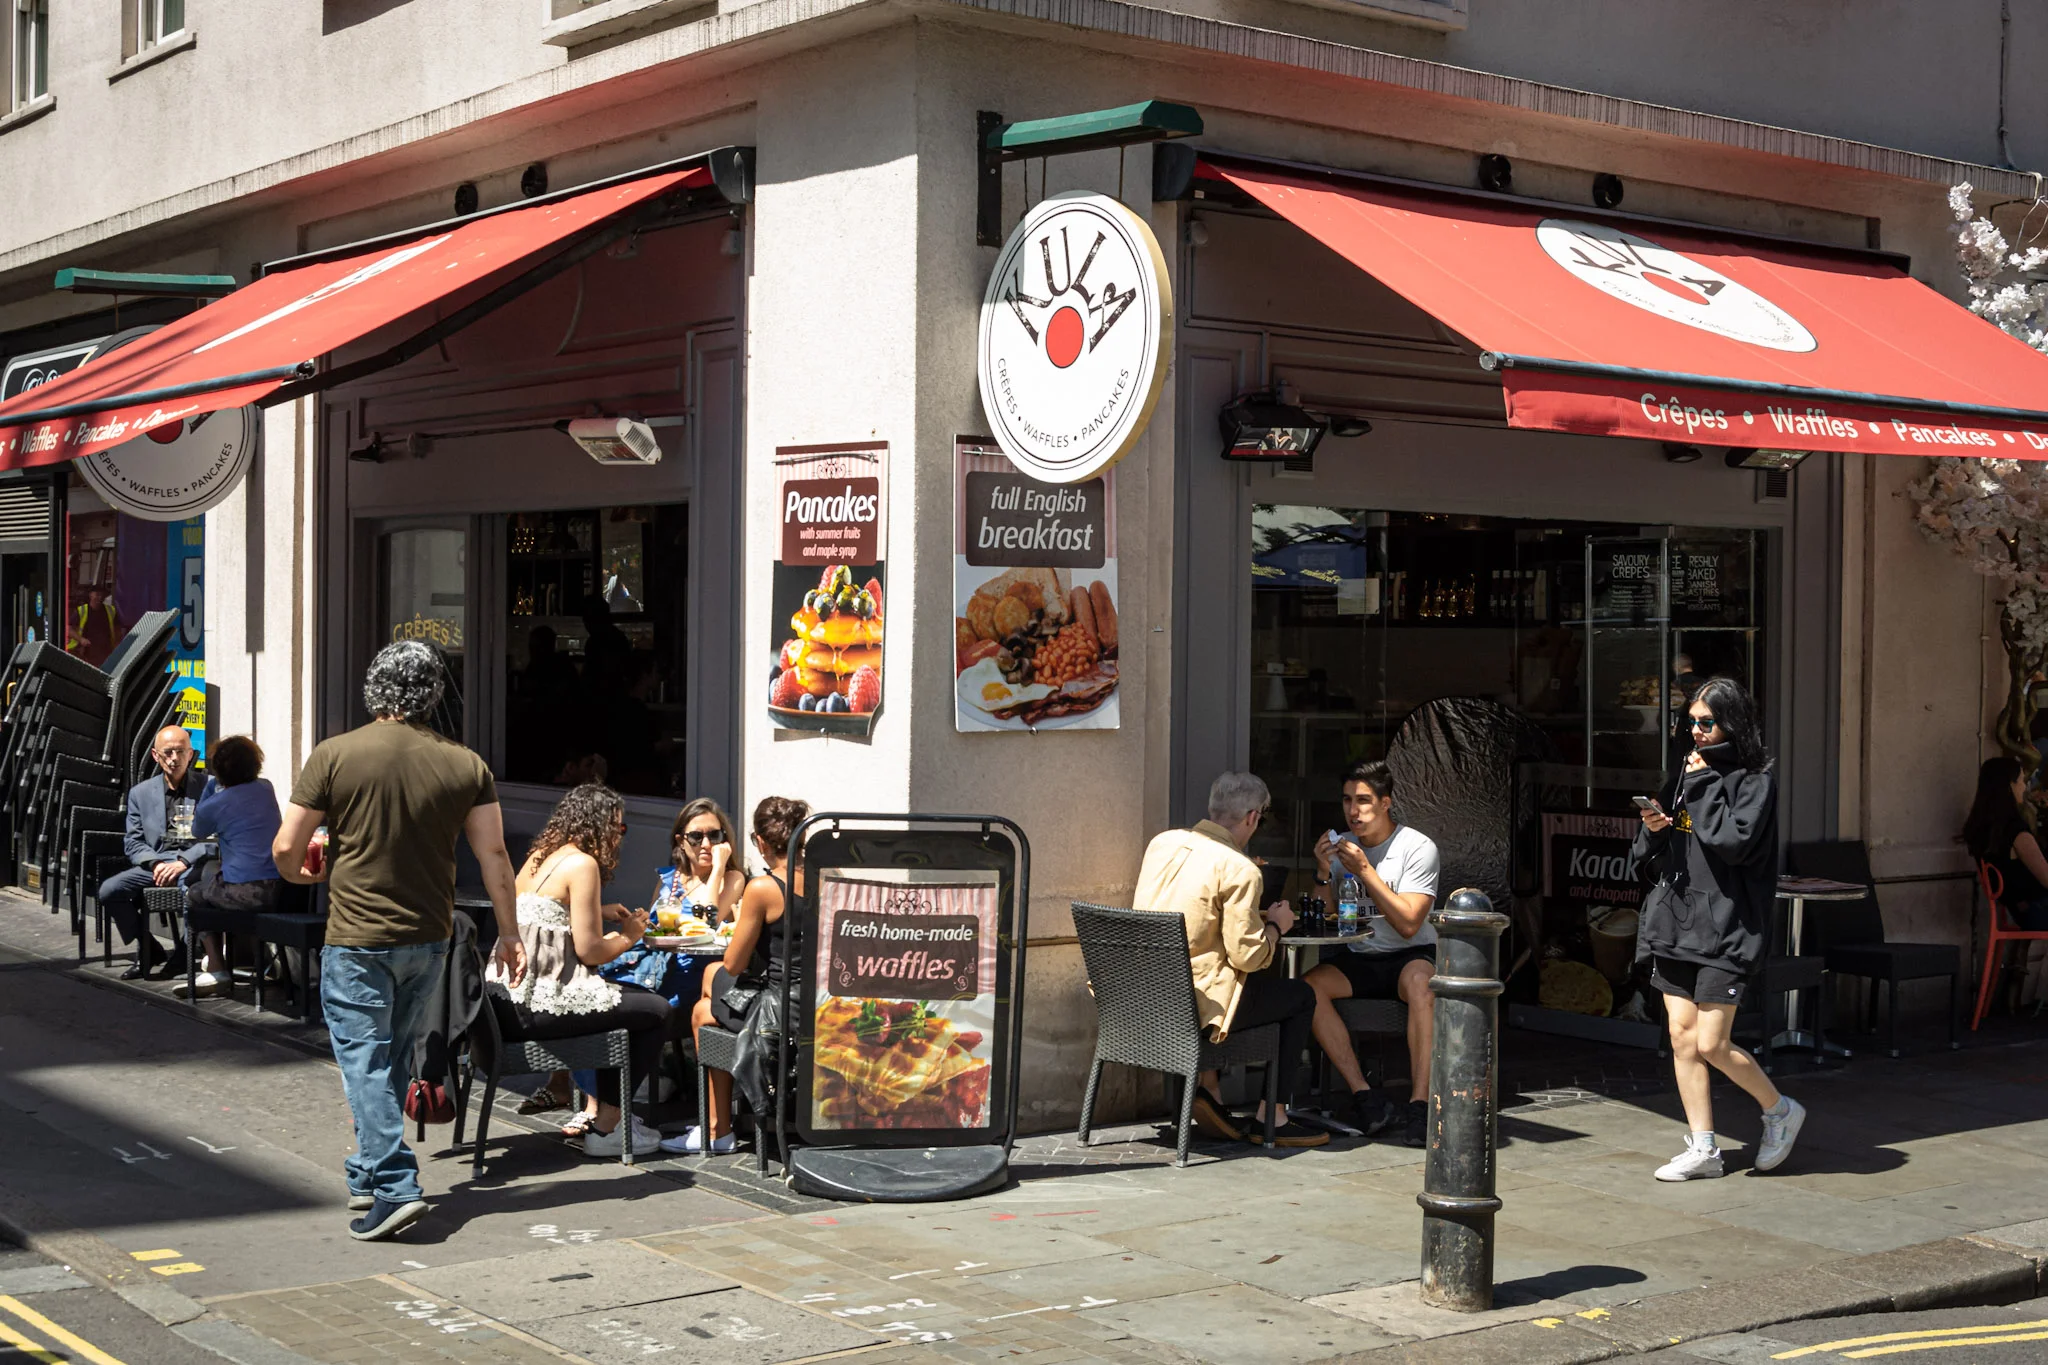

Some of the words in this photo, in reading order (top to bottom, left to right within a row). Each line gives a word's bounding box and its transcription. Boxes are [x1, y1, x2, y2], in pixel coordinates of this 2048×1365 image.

[1003, 225, 1137, 354] KULA
[997, 357, 1018, 415] CRÊPES
[1022, 422, 1070, 448] WAFFLES
[1080, 368, 1129, 440] PANCAKES
[20, 425, 59, 455] Waffles
[72, 415, 130, 447] Pancakes
[1640, 393, 1729, 435] Crêpes
[1767, 405, 1859, 439] Waffles
[1890, 418, 1997, 447] Pancakes
[129, 479, 181, 498] WAFFLES
[191, 442, 233, 491] PANCAKES
[784, 484, 878, 524] Pancakes
[990, 485, 1022, 510] full
[1023, 488, 1087, 518] English
[799, 526, 815, 540] with
[815, 528, 844, 540] summer
[843, 526, 861, 540] fruits
[978, 516, 1094, 551] breakfast
[802, 544, 817, 557] and
[816, 544, 838, 560] maple
[838, 546, 858, 560] syrup
[1612, 554, 1651, 567] SAVOURY
[1688, 555, 1720, 567] RESHLY
[1612, 566, 1651, 579] CREPES
[181, 556, 203, 651] 5
[1686, 588, 1720, 597] ASTRIES
[193, 700, 205, 712] PLAC
[1568, 847, 1641, 882] Karak
[1569, 883, 1593, 899] and
[1593, 884, 1641, 904] chapatti
[839, 919, 878, 938] fresh
[879, 922, 973, 942] home-made
[857, 950, 956, 980] waffles
